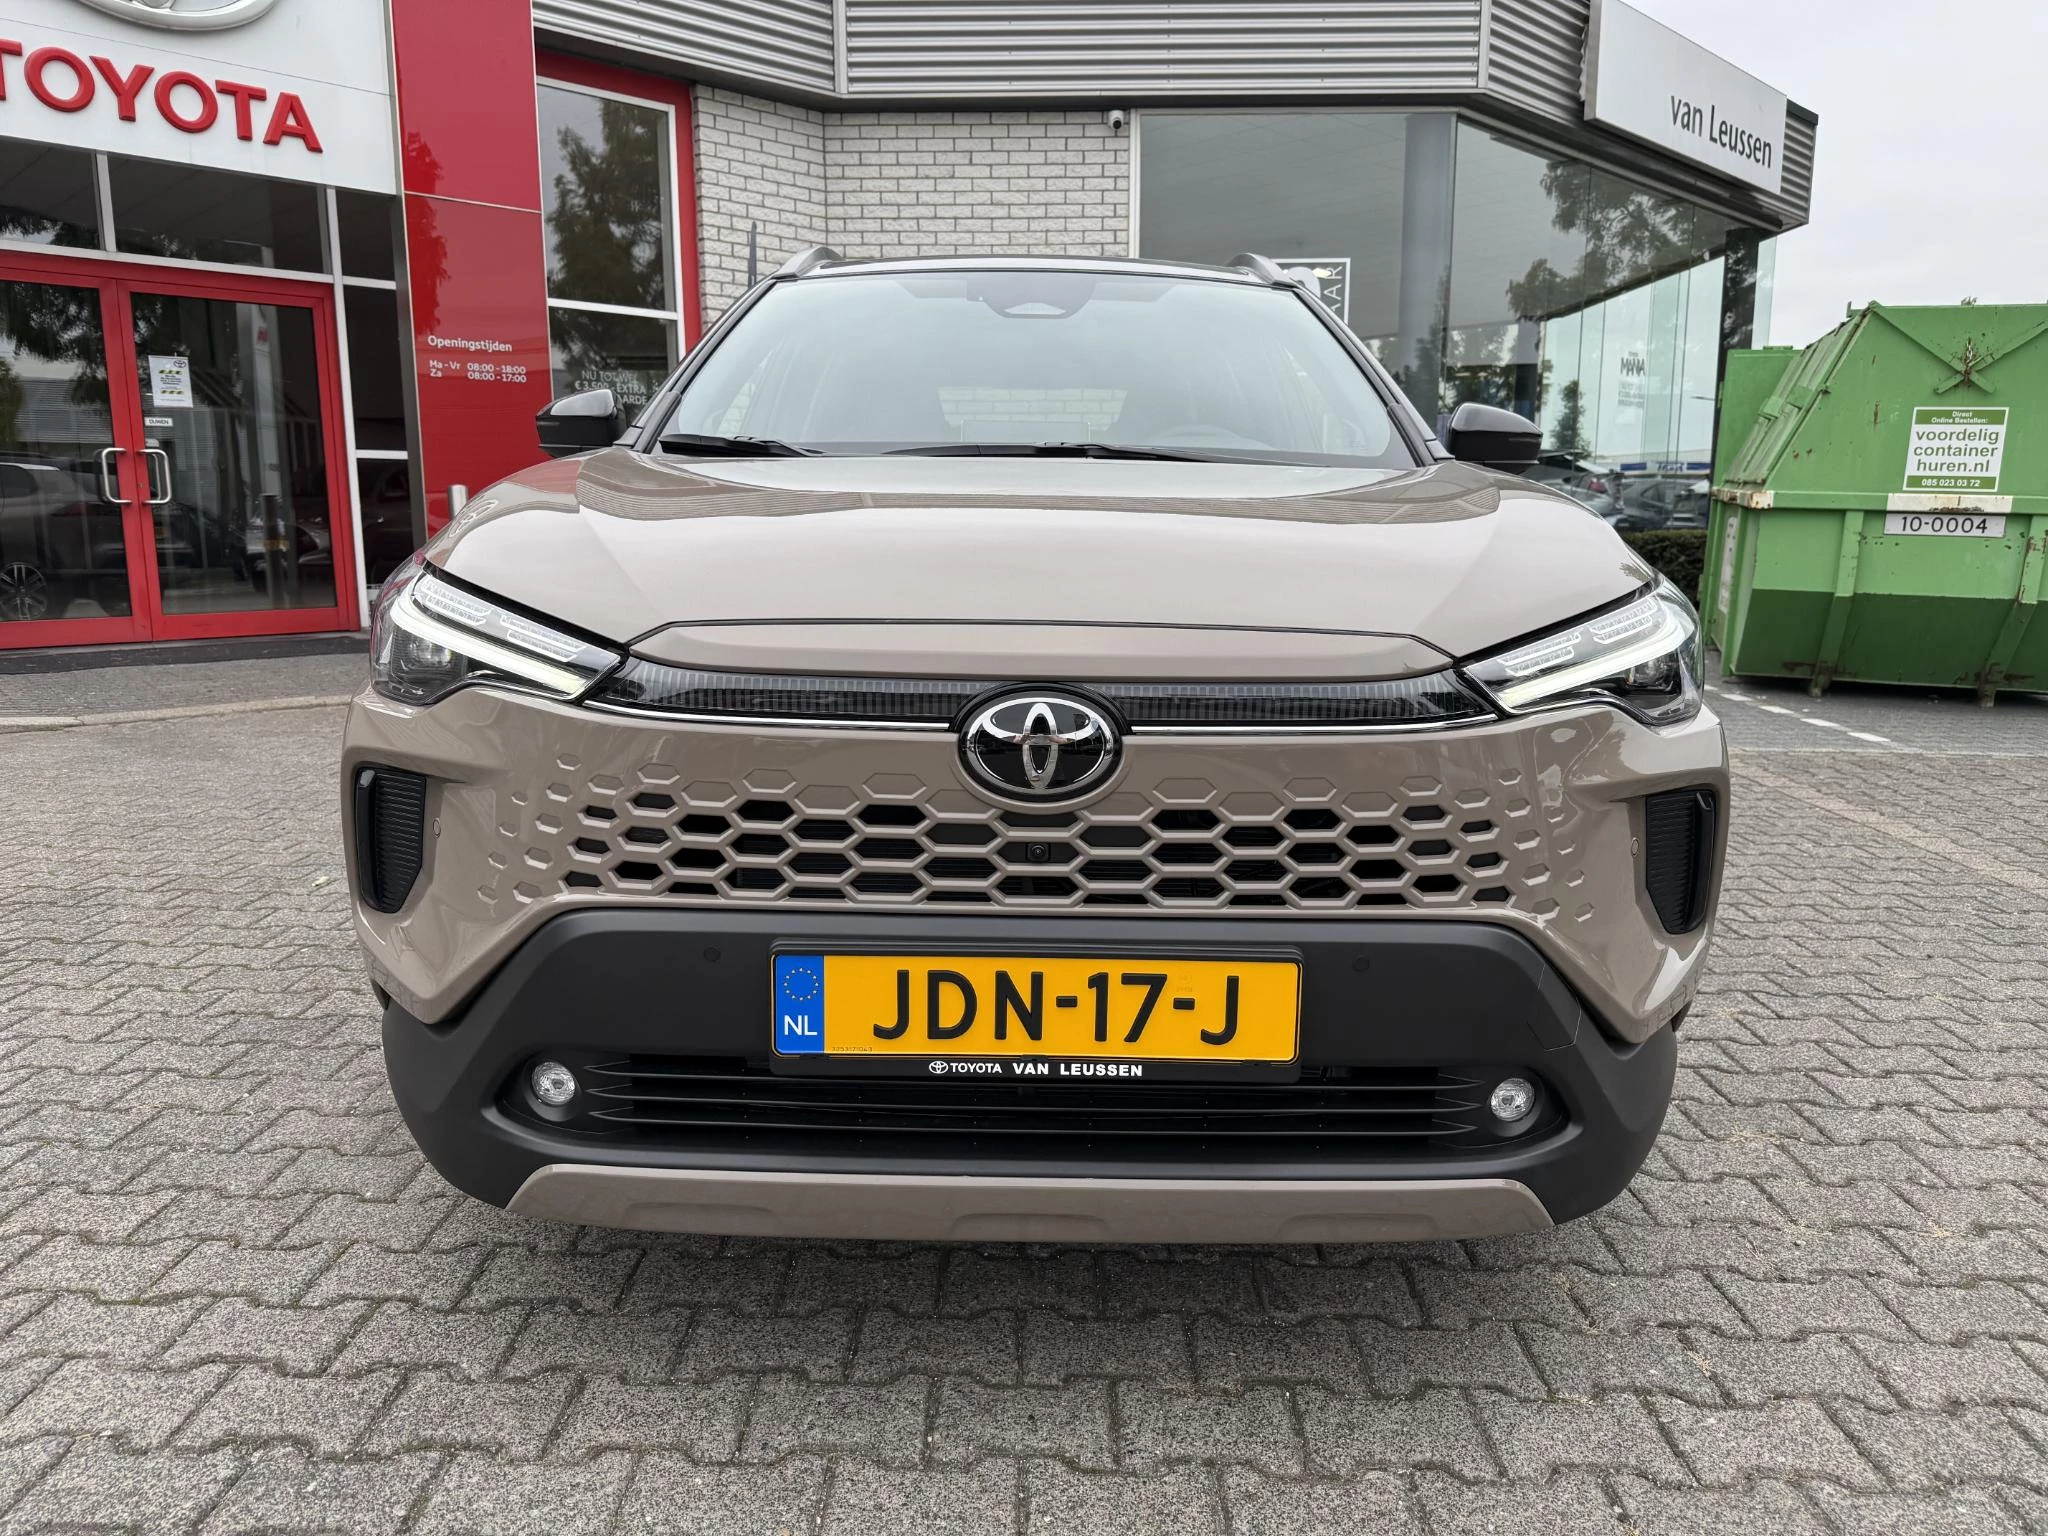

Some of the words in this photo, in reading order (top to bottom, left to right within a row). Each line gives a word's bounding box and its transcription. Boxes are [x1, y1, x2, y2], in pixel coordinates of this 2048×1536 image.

[1671, 95, 1703, 137] van
[1709, 104, 1773, 169] Leussen
[427, 335, 513, 352] Openingstijden
[429, 360, 443, 369] Ma
[449, 361, 461, 370] Vr
[467, 362, 495, 372] 08:00
[501, 365, 526, 374] 18:00
[430, 369, 443, 377] Za
[467, 372, 495, 381] 08:00
[502, 374, 527, 383] 17:00
[616, 383, 647, 395] EXTRA
[1915, 428, 2000, 445] voordelig
[1913, 444, 1998, 457] container
[1916, 459, 1990, 473] huren.nl
[1939, 479, 1955, 487] 023
[1901, 516, 1988, 534] 10-0004
[872, 969, 1240, 1046] JDN-17-J
[783, 1015, 818, 1036] NL
[950, 1062, 1003, 1074] TOYOTA
[1012, 1063, 1049, 1075] VAN
[1060, 1063, 1143, 1076] LEUSSEN
